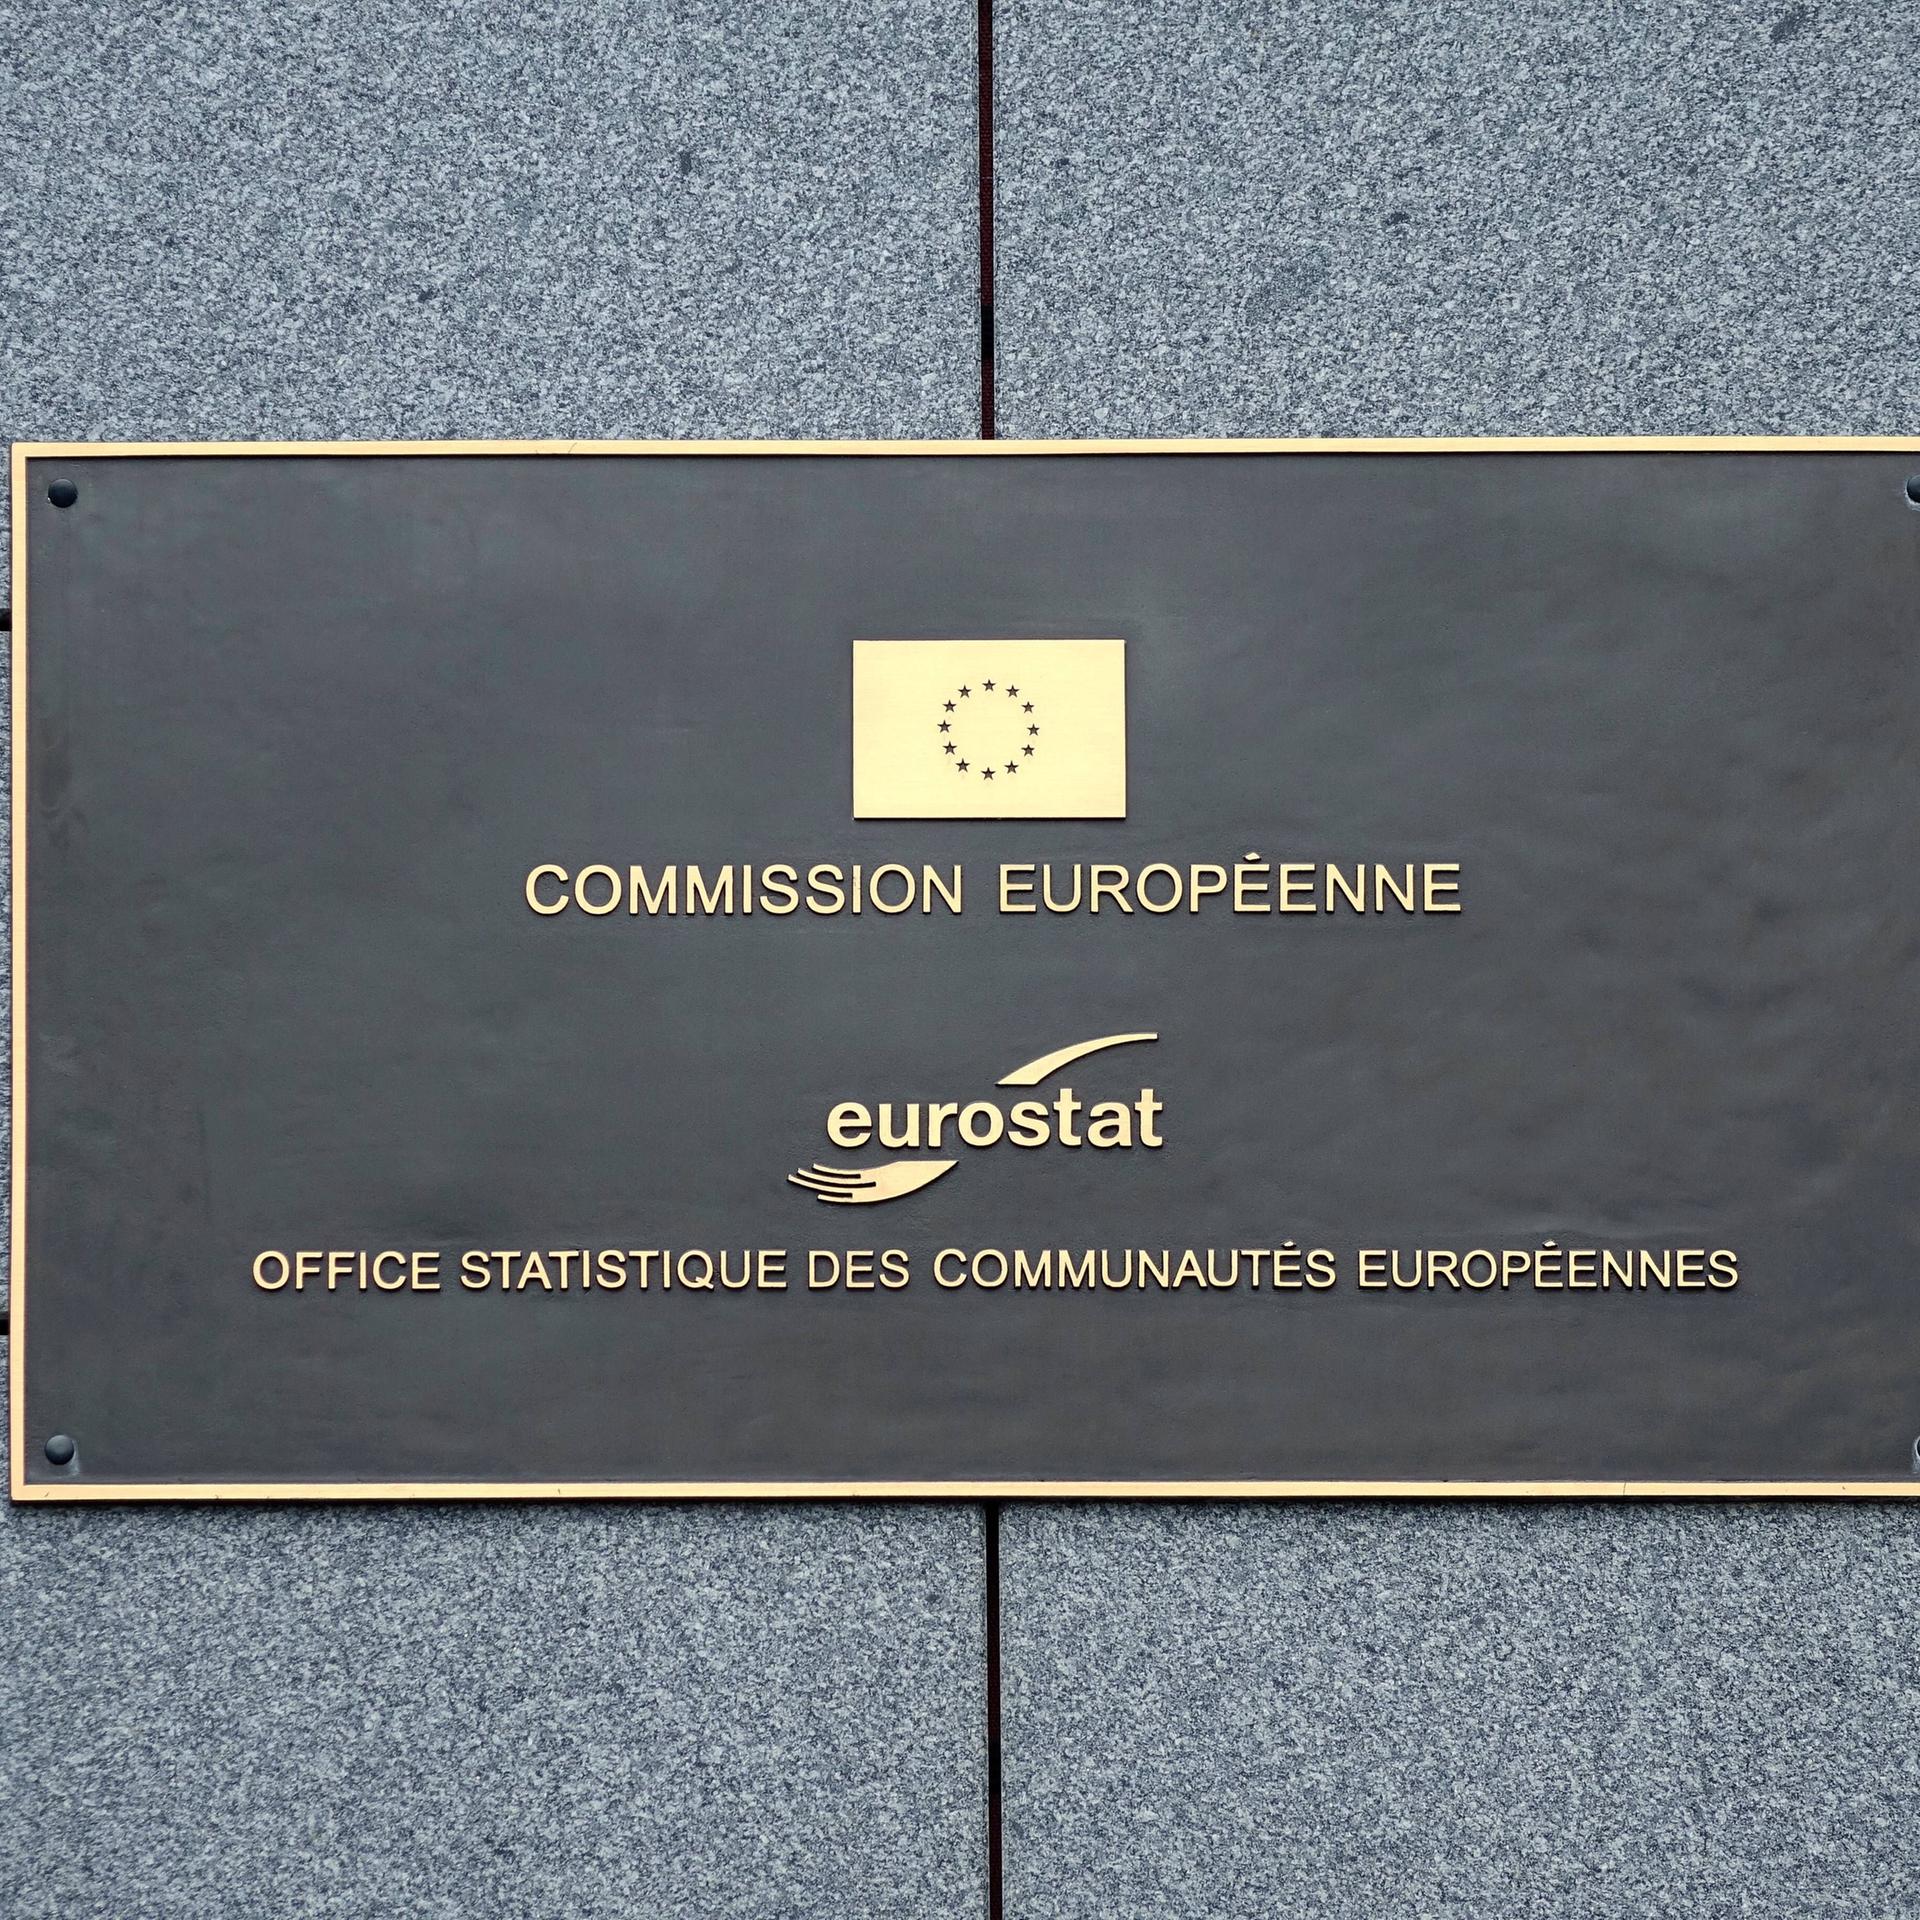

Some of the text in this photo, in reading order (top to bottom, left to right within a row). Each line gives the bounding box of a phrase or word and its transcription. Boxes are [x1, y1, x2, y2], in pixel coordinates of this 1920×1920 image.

[524, 851, 1463, 916] COMMISSION EUROPÉENNE
[826, 1086, 1164, 1149] eurostat
[251, 1239, 1740, 1291] OFFICE STATISTIQUE DES COMMUNAUTÉS EUROPÉENNES
